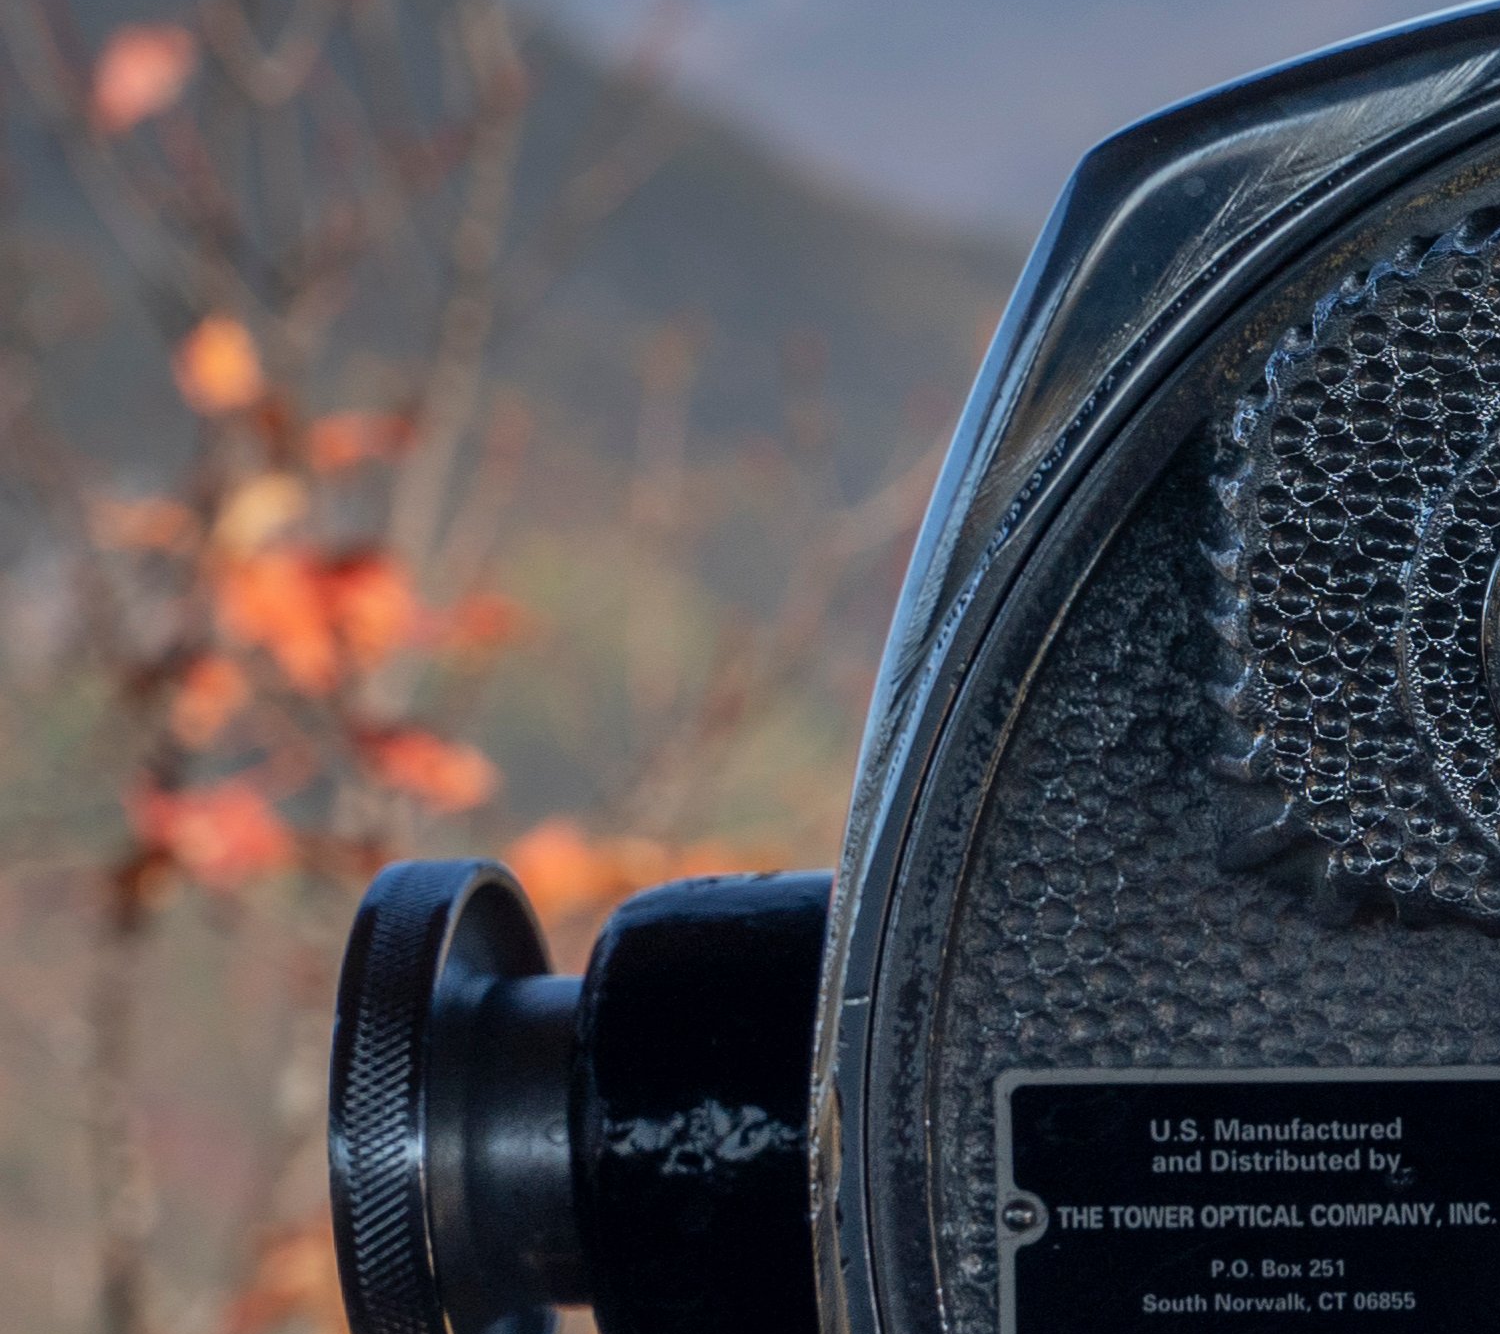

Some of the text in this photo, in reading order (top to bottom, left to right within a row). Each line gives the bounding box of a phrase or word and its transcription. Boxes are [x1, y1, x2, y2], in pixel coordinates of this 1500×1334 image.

[1151, 1117, 1402, 1141] U.S. Manufactured
[1152, 1149, 1400, 1173] and Distributed by
[1057, 1202, 1496, 1228] THE TOWER OPTICAL COMPANY, INC.
[1211, 1259, 1344, 1278] P.O. Box 251
[1143, 1292, 1416, 1312] South Norwalk, CT 06855
